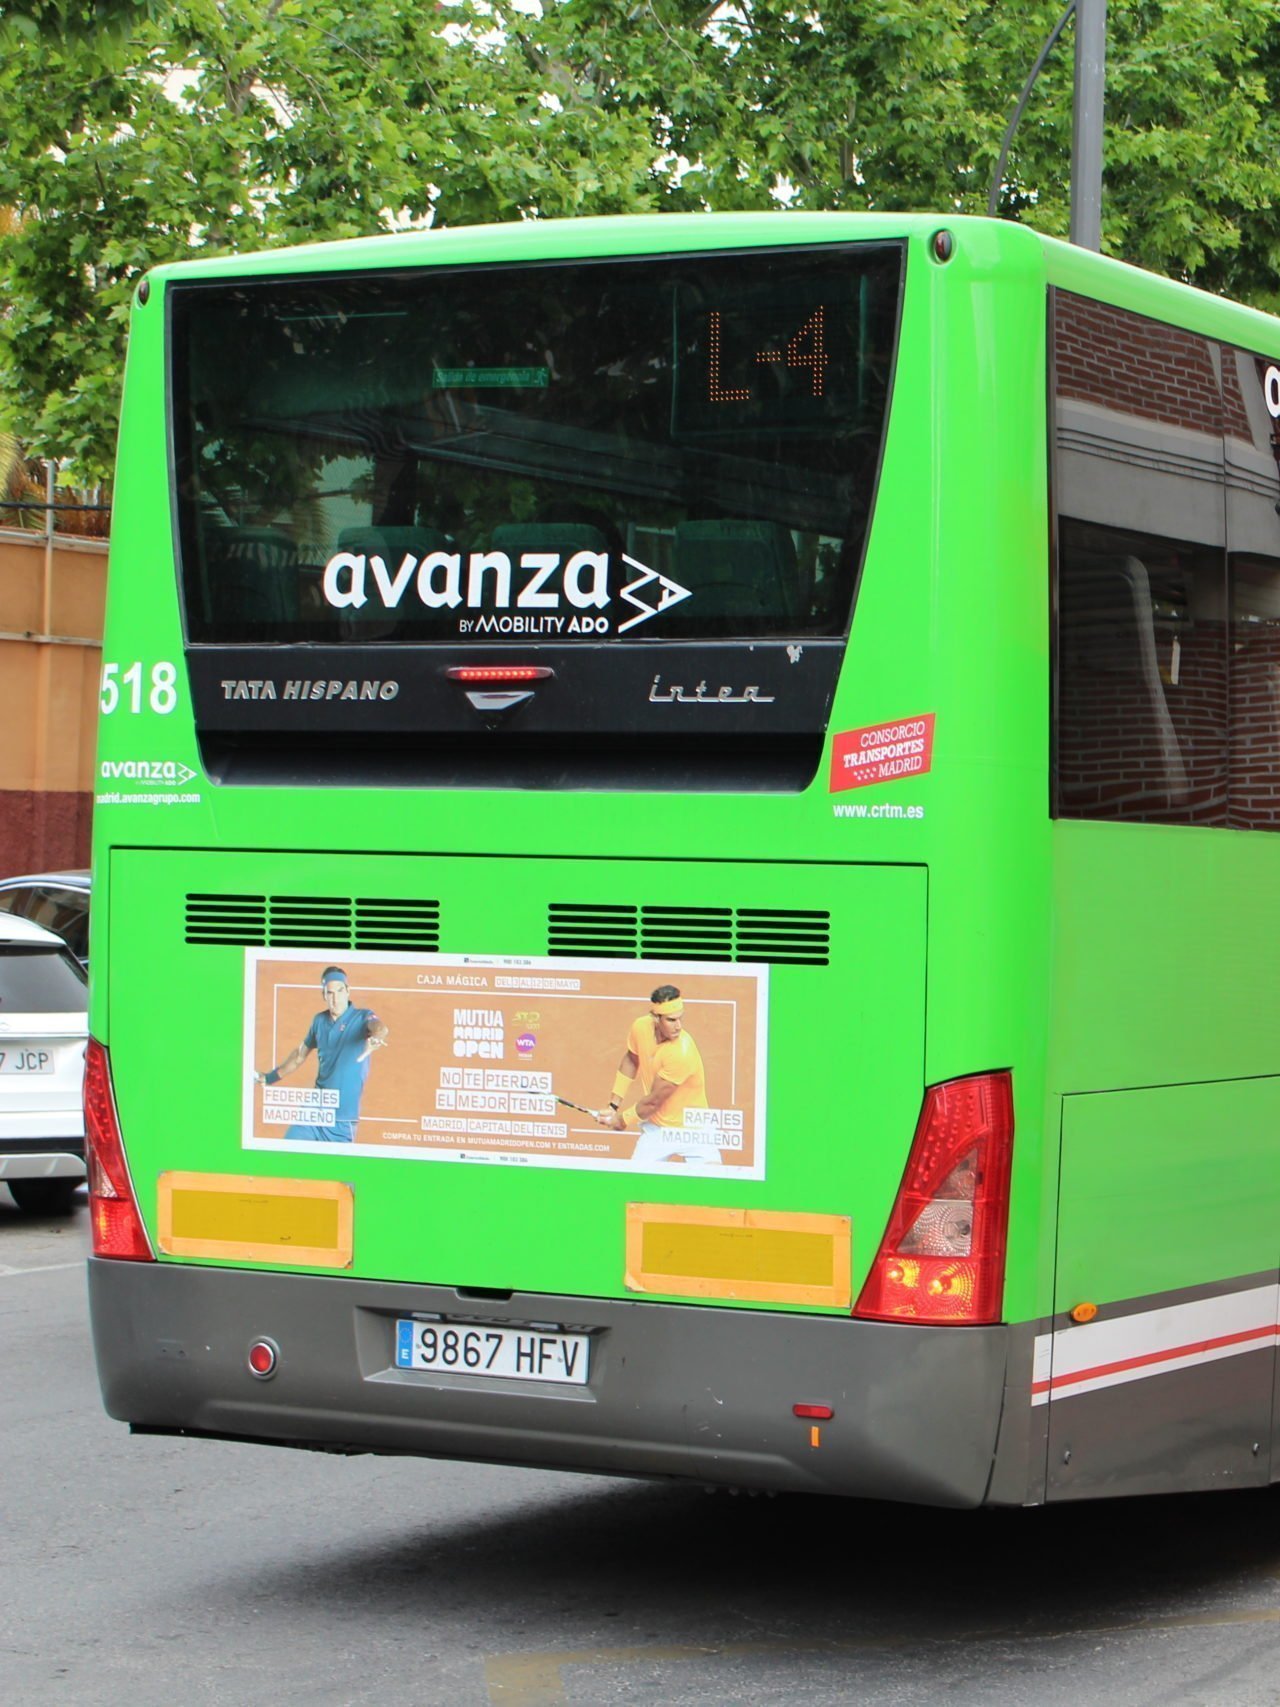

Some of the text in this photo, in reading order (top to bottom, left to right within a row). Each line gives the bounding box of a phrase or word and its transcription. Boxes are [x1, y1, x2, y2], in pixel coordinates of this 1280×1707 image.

[709, 305, 829, 400] L-4
[323, 550, 612, 609] avanza
[459, 614, 609, 633] BY MOBILITY ADO
[100, 661, 177, 715] 518
[221, 680, 400, 701] TATA HISPANO
[860, 720, 925, 748] CONSORCIO
[843, 738, 925, 769] TRANSPORTES
[101, 760, 177, 778] avanza
[878, 755, 923, 778] MADRID
[832, 803, 925, 820] www.crtm.es
[416, 974, 443, 985] CAJA
[446, 973, 488, 987] MÁGICA
[453, 1009, 504, 1027] MUTUA
[453, 1026, 504, 1041] MADRID
[516, 1038, 535, 1047] WTA
[15, 1051, 49, 1069] JCP
[441, 1071, 549, 1090] NO TE PIERDAS
[265, 1089, 338, 1104] FEDERER ES
[437, 1093, 554, 1112] EL MEJOR TENIS
[685, 1110, 742, 1126] RAFA ES
[469, 1120, 511, 1133] CAPITAL
[513, 1122, 533, 1134] DEL
[536, 1123, 566, 1136] TENIS
[382, 1131, 412, 1141] COMPRA
[413, 1133, 422, 1141] TU
[423, 1134, 455, 1144] ENTRADA
[456, 1136, 466, 1144] EN
[662, 1129, 741, 1147] MADRILEÑO
[401, 1327, 580, 1377] E 9867 HFV
